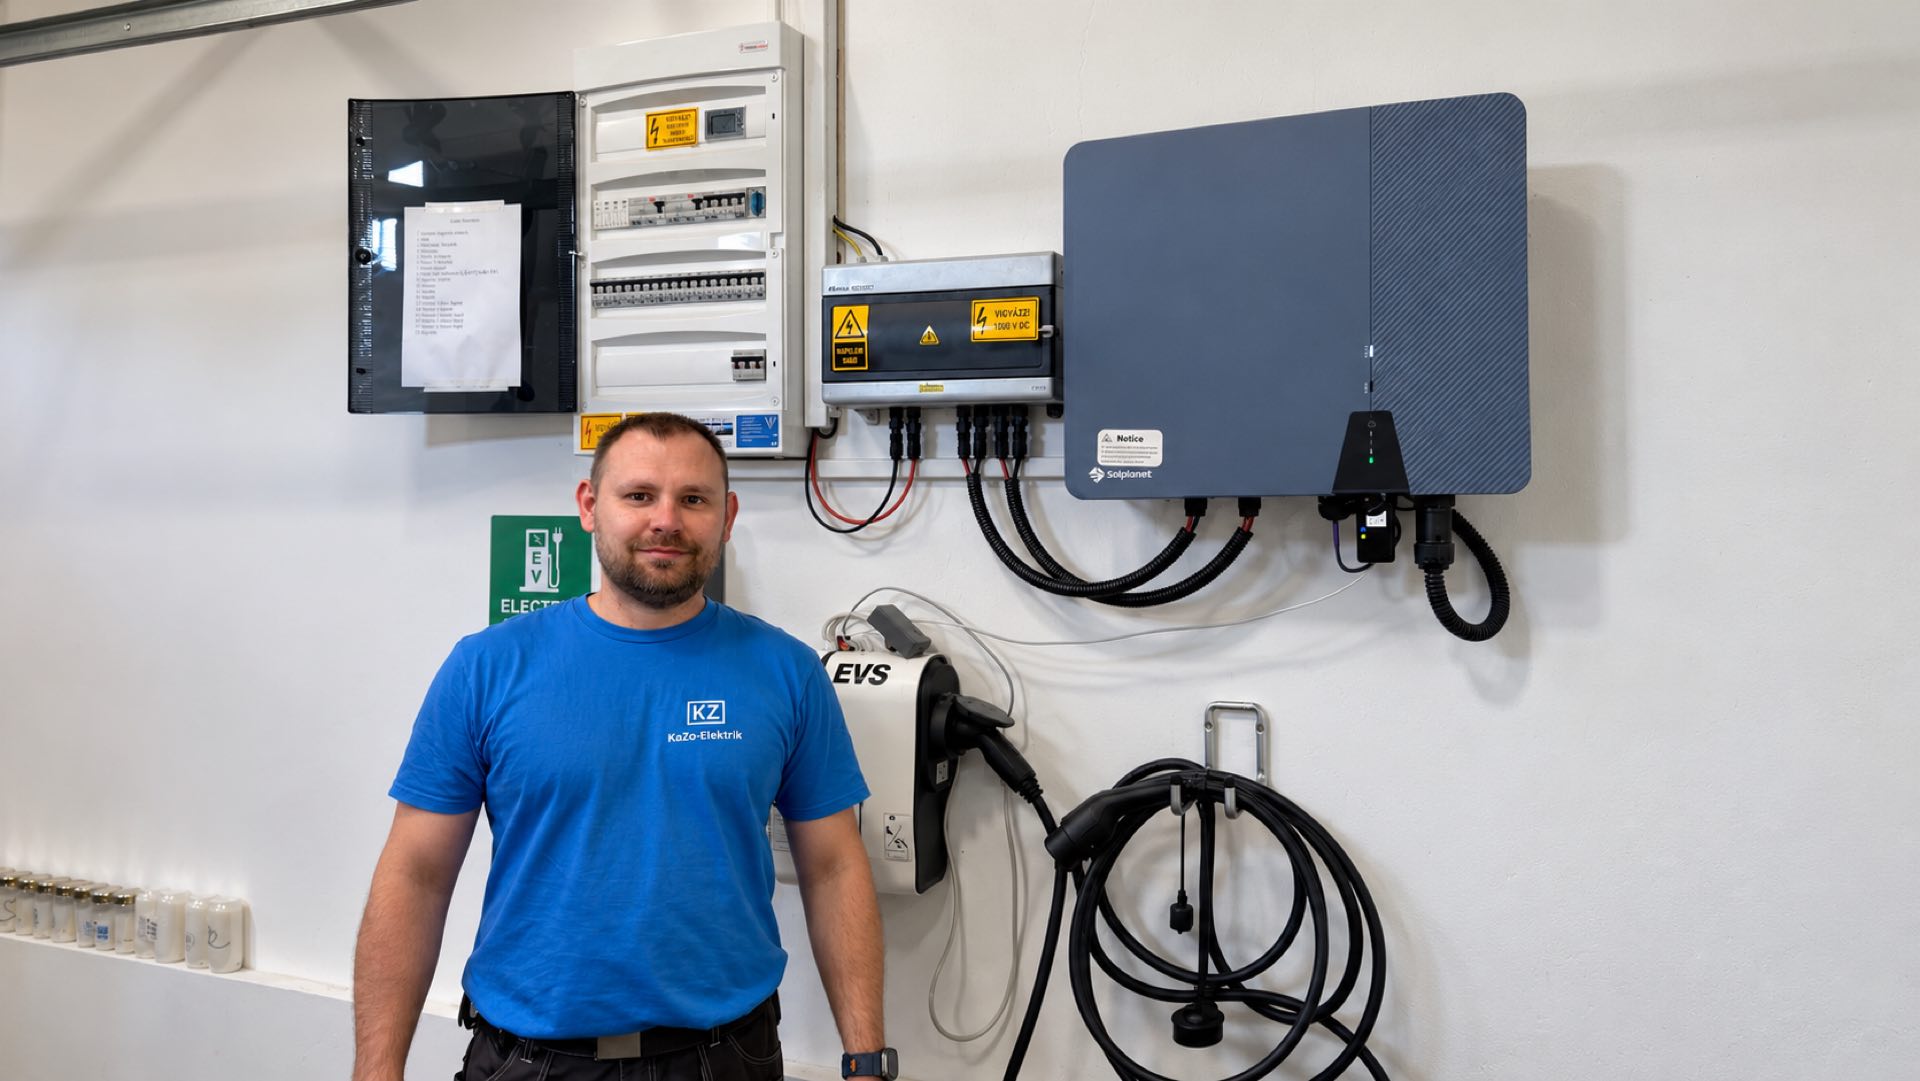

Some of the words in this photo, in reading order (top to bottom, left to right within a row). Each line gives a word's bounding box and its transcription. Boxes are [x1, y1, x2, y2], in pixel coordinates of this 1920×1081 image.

[1012, 322, 1018, 330] V
[1019, 321, 1030, 330] DC
[1117, 434, 1144, 442] Notice
[1107, 470, 1152, 480] Solplanet
[833, 663, 891, 686] EVS
[693, 704, 720, 721] KZ
[667, 730, 743, 743] KaZo-Elektrik
